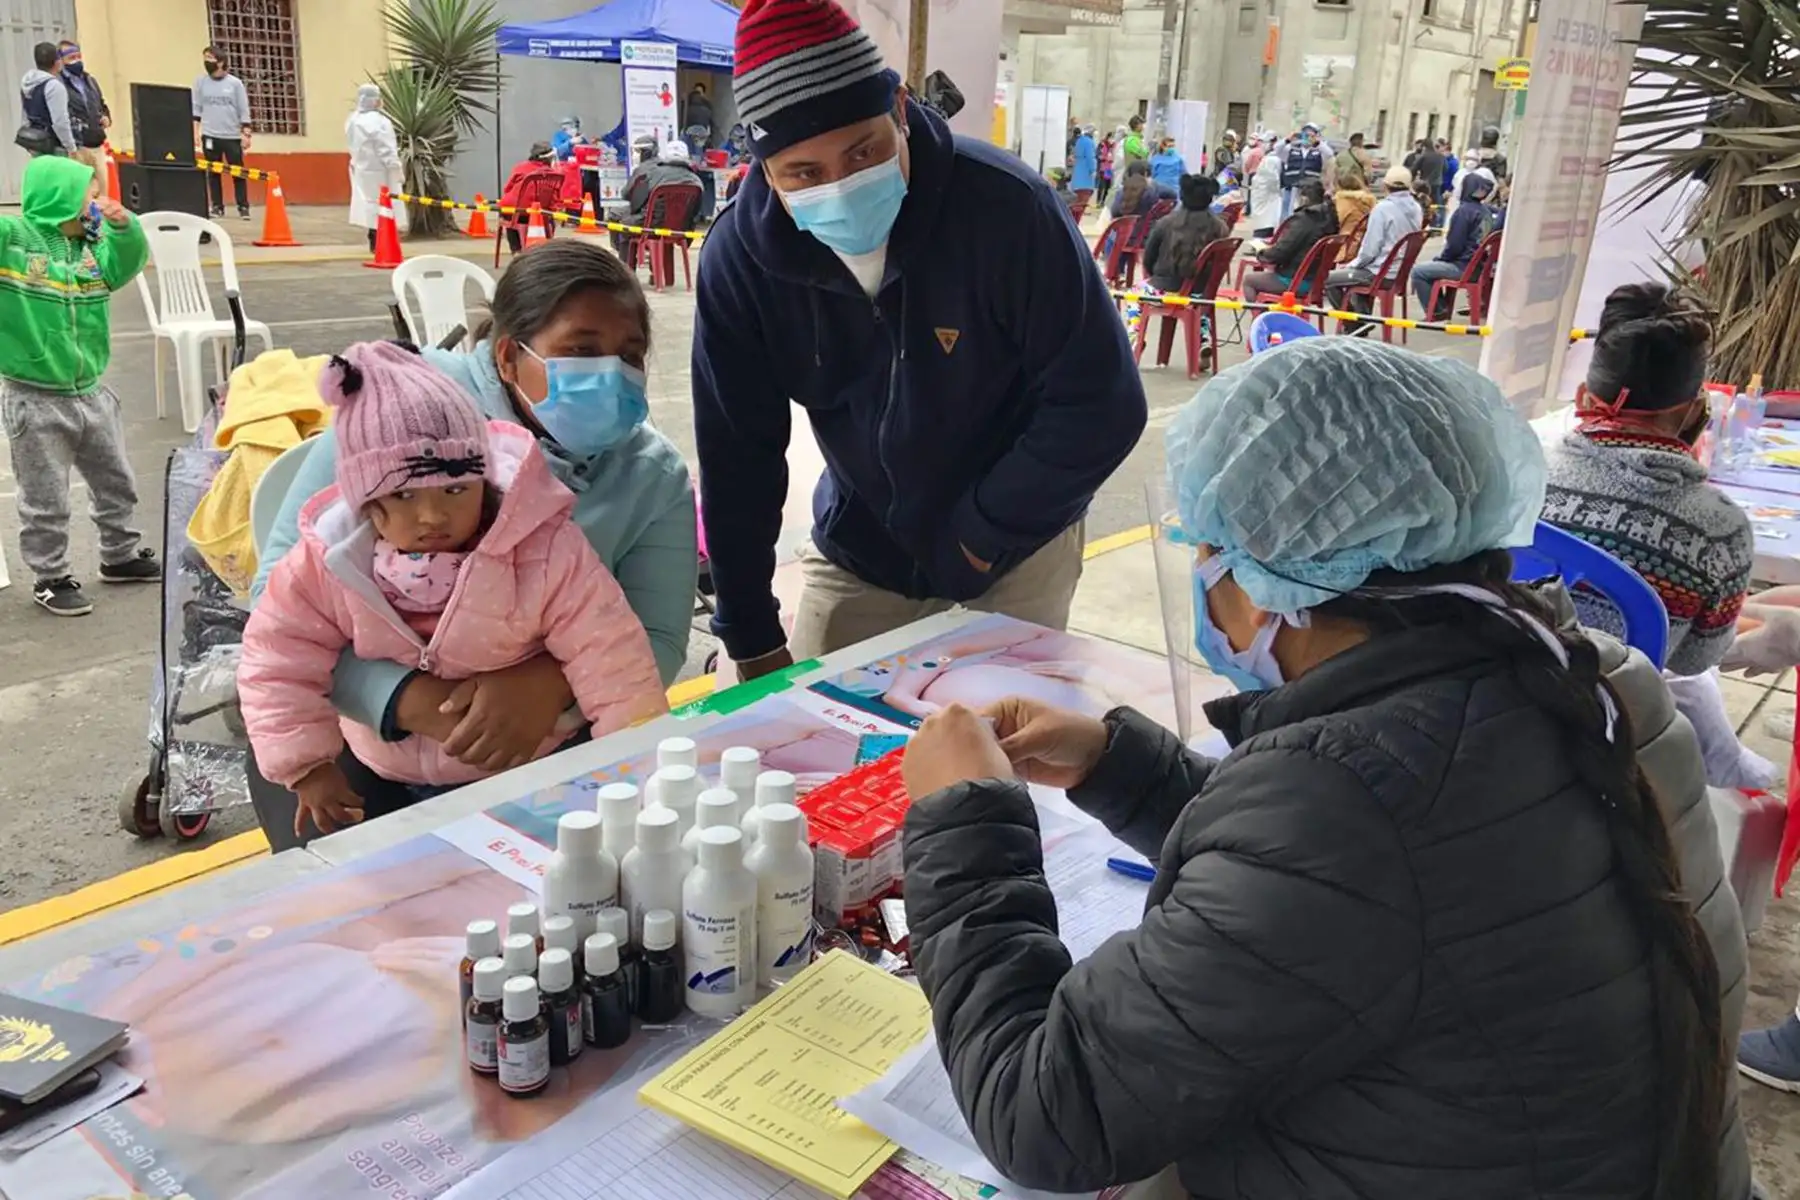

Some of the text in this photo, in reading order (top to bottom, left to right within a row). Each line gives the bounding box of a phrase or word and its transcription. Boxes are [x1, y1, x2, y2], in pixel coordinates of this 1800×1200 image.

[92, 1111, 183, 1196] ntes sin ane
[381, 1138, 445, 1186] animal
[398, 1111, 464, 1167] Prioriza
